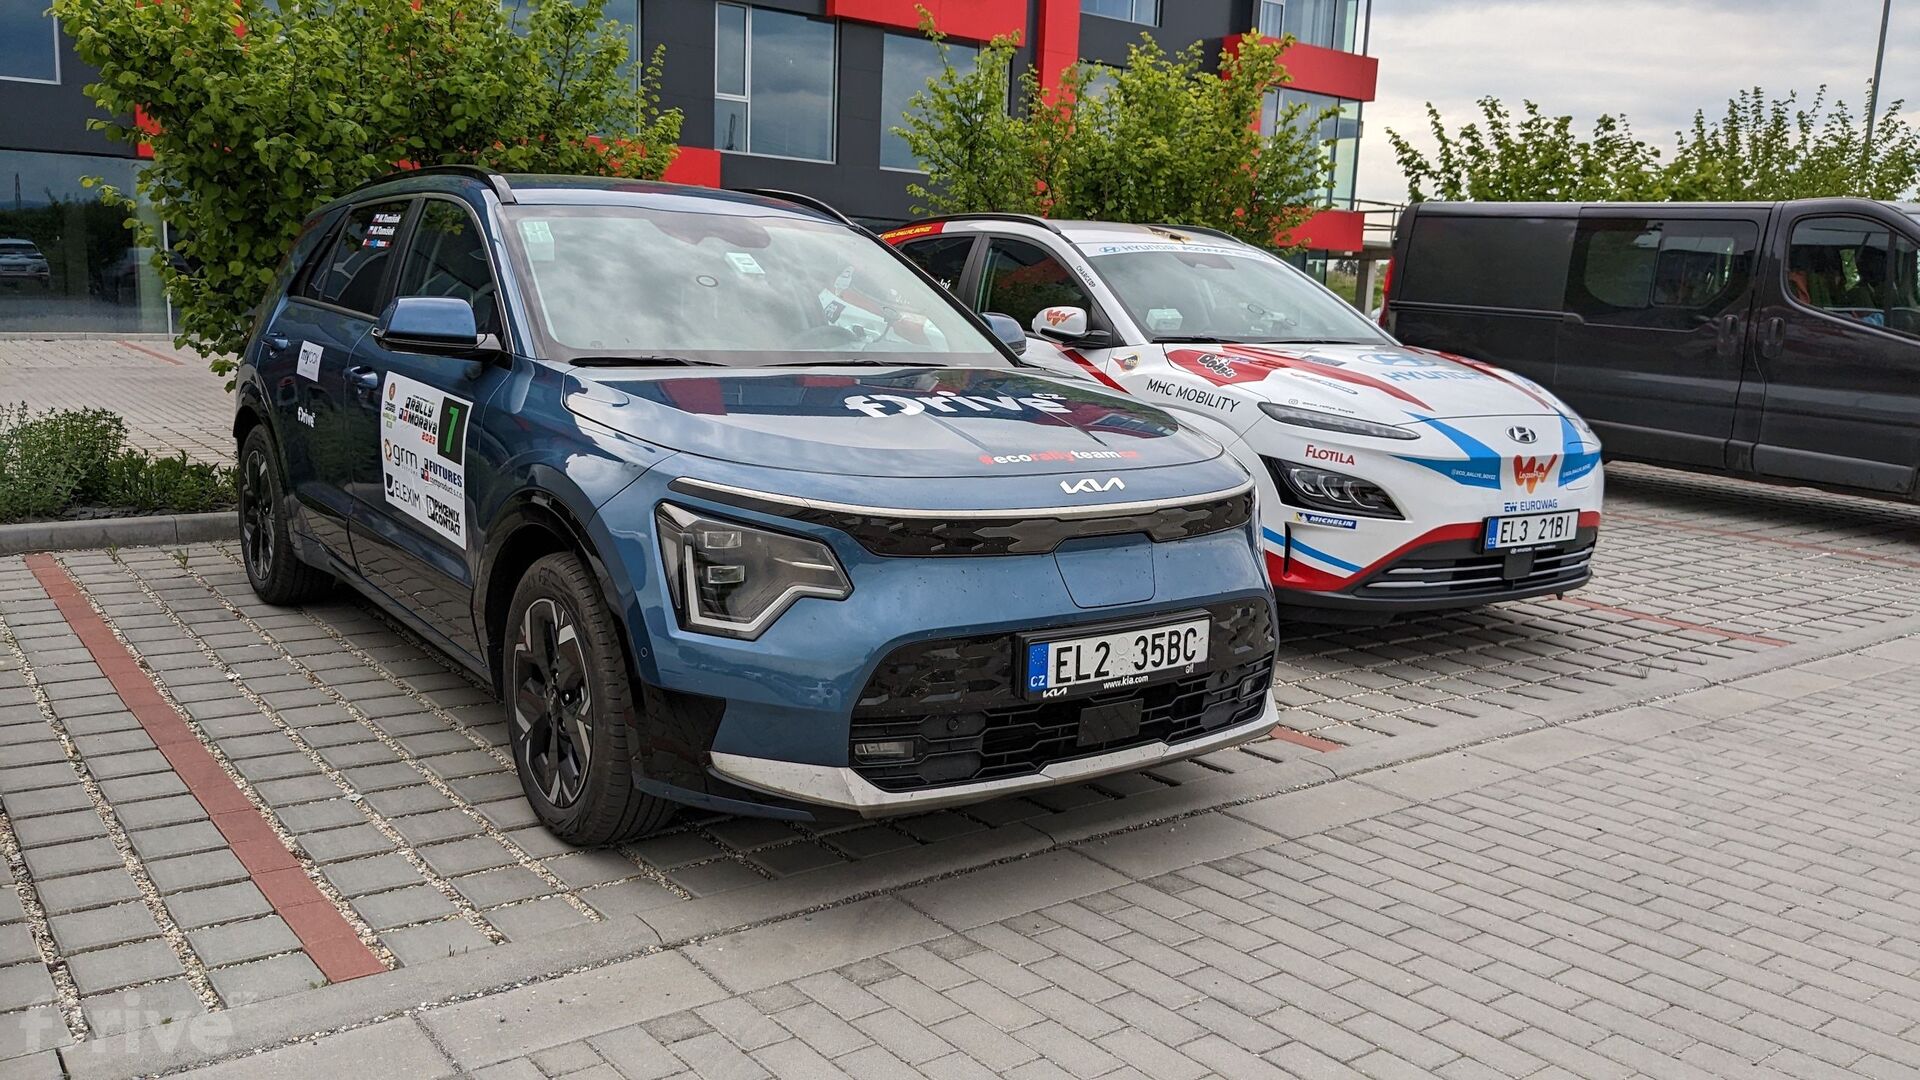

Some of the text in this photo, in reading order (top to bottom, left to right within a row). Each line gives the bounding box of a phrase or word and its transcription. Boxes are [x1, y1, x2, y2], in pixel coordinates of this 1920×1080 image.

[1147, 378, 1241, 413] MHC MOBILITY
[421, 431, 437, 446] 2023
[393, 444, 418, 470] grm
[1305, 444, 1355, 466] FLOTILA
[429, 459, 463, 488] FUTURES
[395, 480, 421, 511] ELEXIM
[1520, 498, 1558, 511] EUROWAG
[435, 512, 461, 536] CONTACT
[1309, 515, 1354, 528] MICHELIN
[1500, 515, 1570, 544] EL3 21BI
[1055, 627, 1198, 685] EL2 35BC
[1030, 675, 1046, 687] CZ
[1103, 674, 1149, 690] www.kia.com
